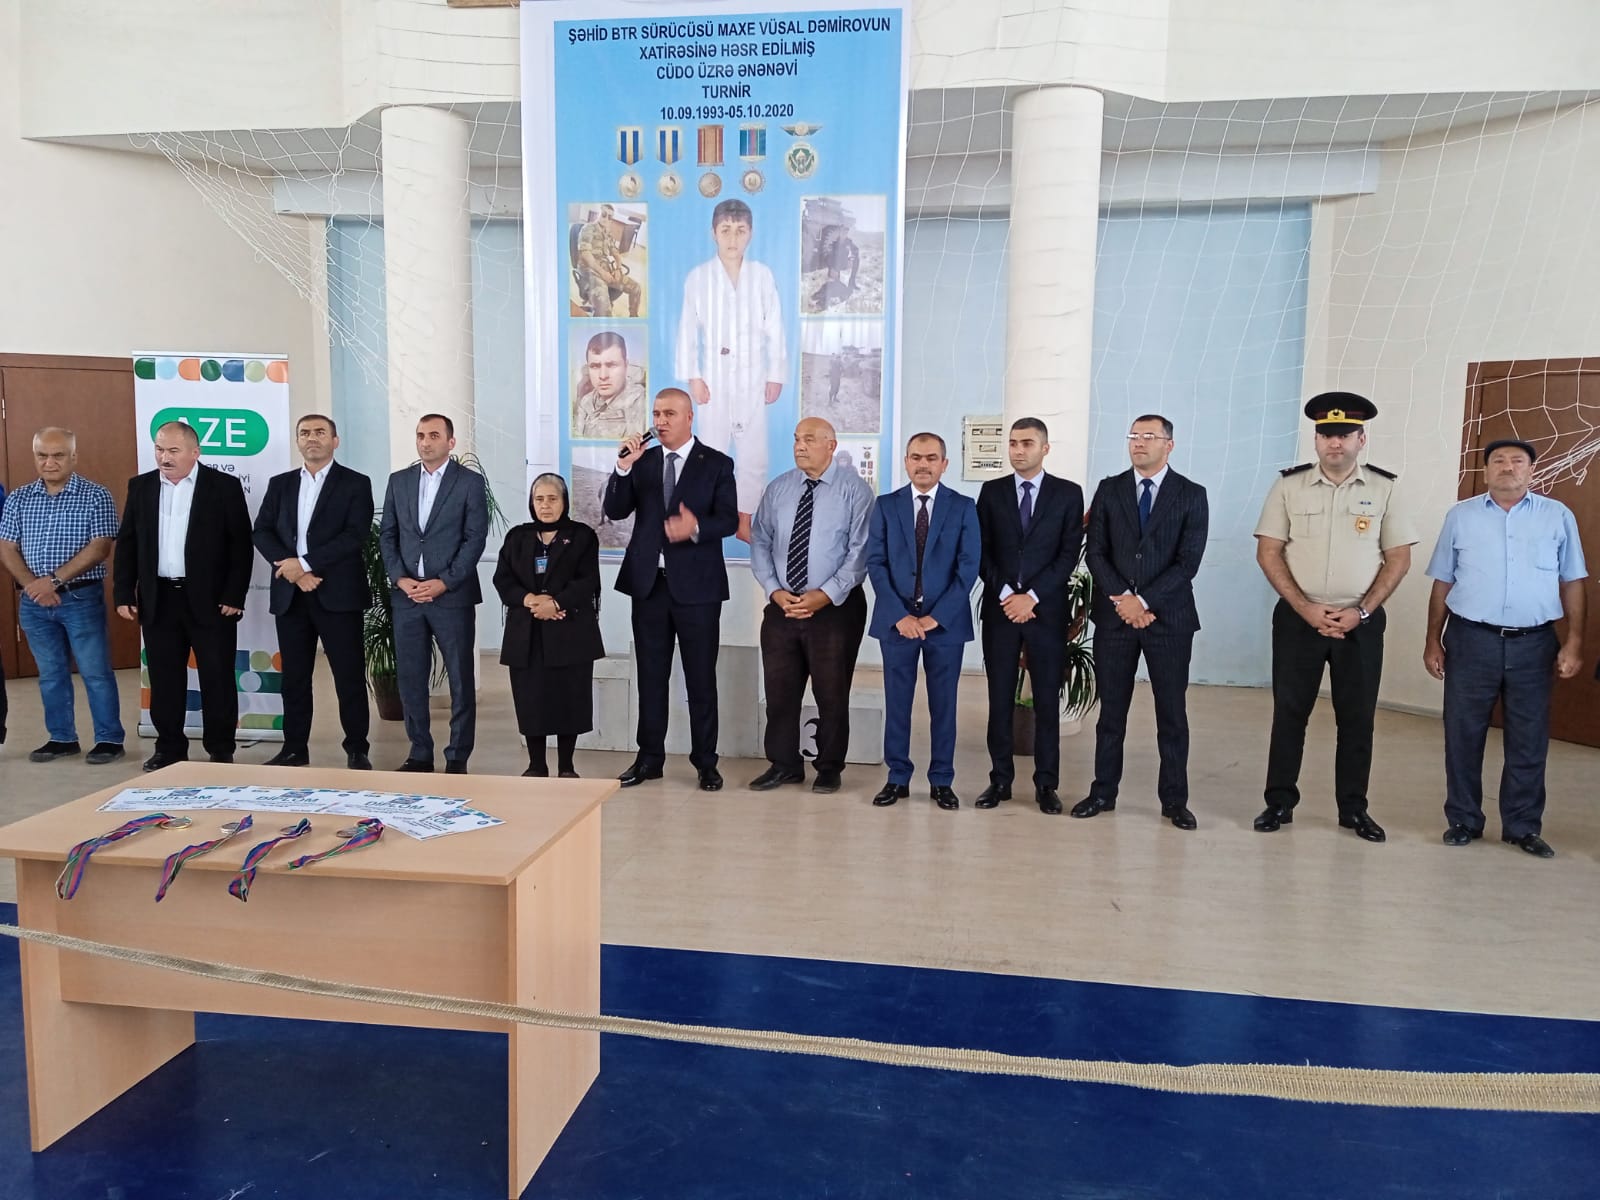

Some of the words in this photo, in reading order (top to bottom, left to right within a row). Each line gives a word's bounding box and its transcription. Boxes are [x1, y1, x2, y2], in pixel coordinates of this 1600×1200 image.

[568, 24, 608, 45] ŞƏHİD
[611, 26, 638, 41] BTR
[641, 20, 714, 40] SÜRÜCÜSÜ
[717, 21, 756, 37] MAXE
[759, 18, 805, 36] VÜSAL
[808, 15, 891, 34] DƏMİROVUN
[639, 41, 717, 60] XATİRƏSİNƏ
[721, 43, 758, 57] HƏSR
[762, 38, 815, 57] EDİLMİŞ
[656, 63, 694, 80] CÜDO
[698, 62, 734, 78] ÜZRƏ
[738, 58, 798, 78] ƏNƏNƏVİ
[702, 81, 751, 99] TURNİR
[660, 103, 794, 121] 10.09.1993-05.10.2020
[177, 416, 246, 448] ZE
[802, 717, 820, 758] 3
